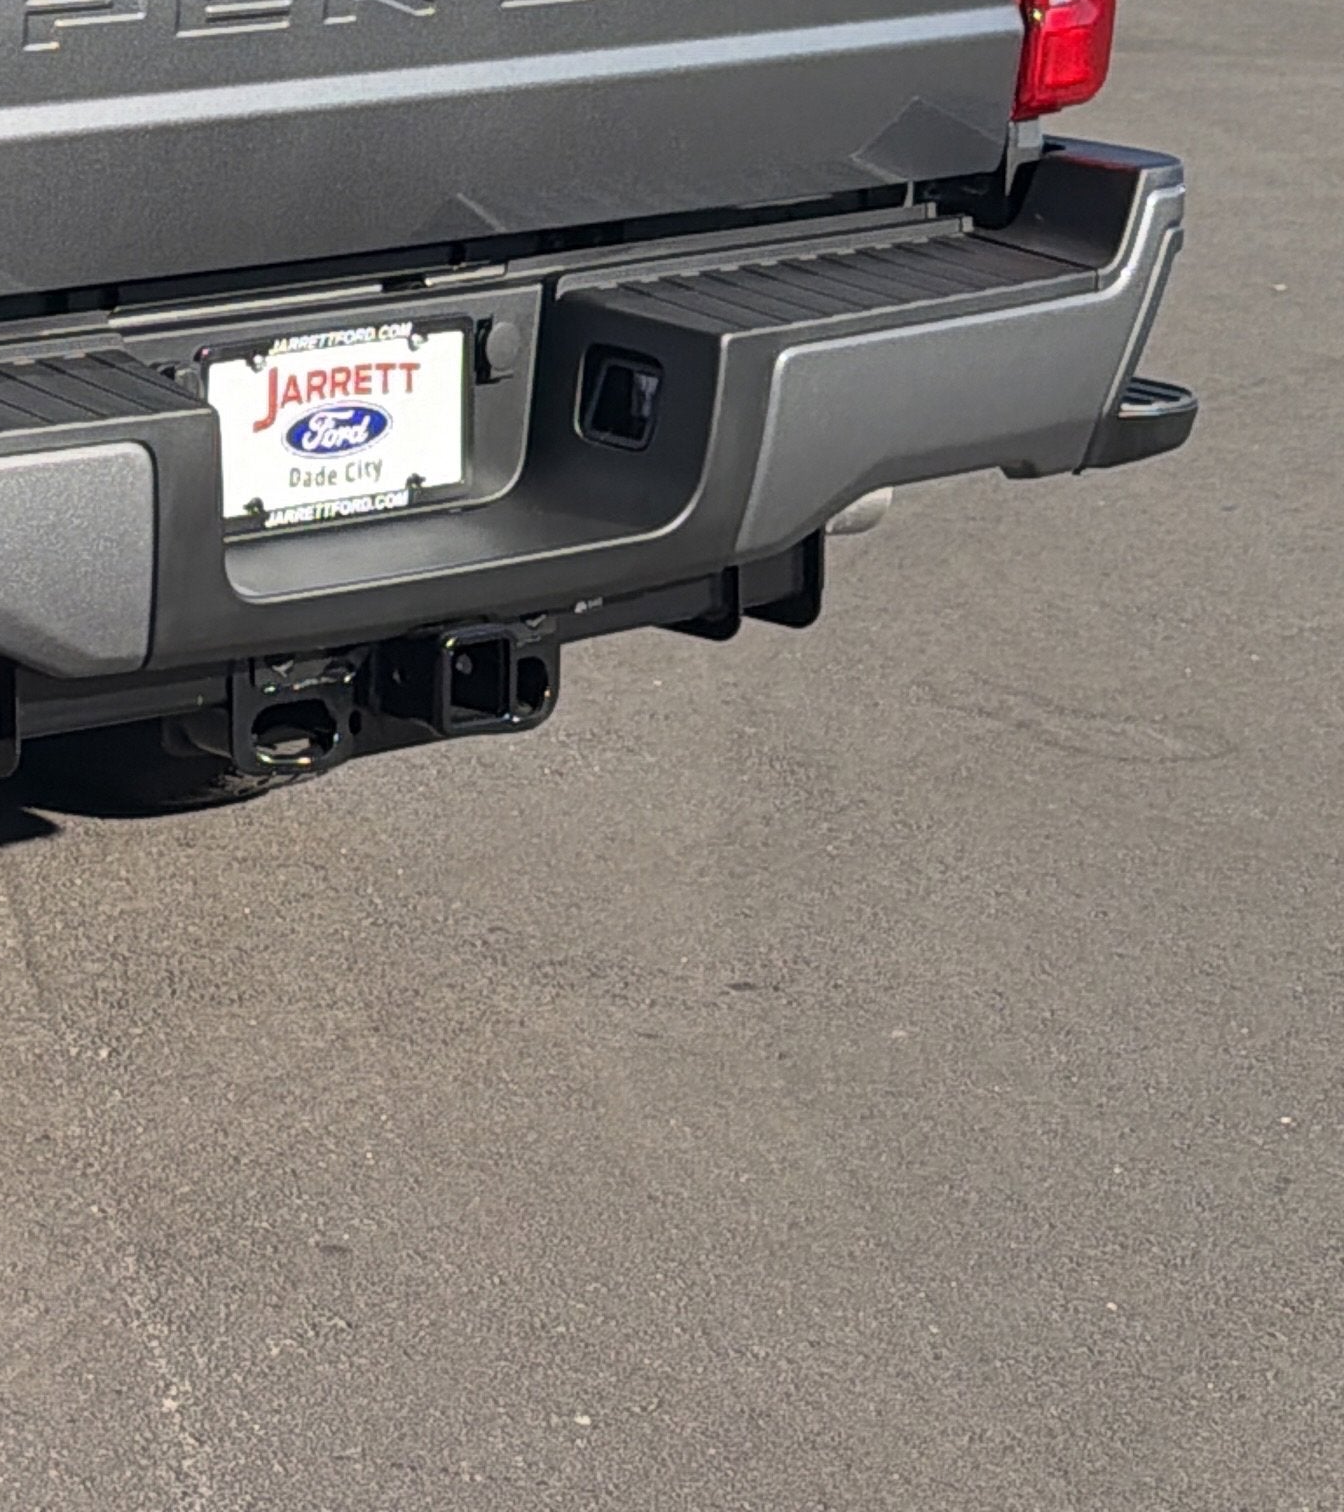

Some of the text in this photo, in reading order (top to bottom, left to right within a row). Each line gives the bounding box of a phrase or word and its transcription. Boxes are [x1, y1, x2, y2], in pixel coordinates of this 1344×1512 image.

[269, 322, 413, 354] JARRETTFORD.COM
[252, 362, 421, 433] JARRETT
[301, 409, 372, 451] Ford
[288, 458, 384, 488] Dade City
[265, 489, 409, 527] JARRETTFORD.COM
